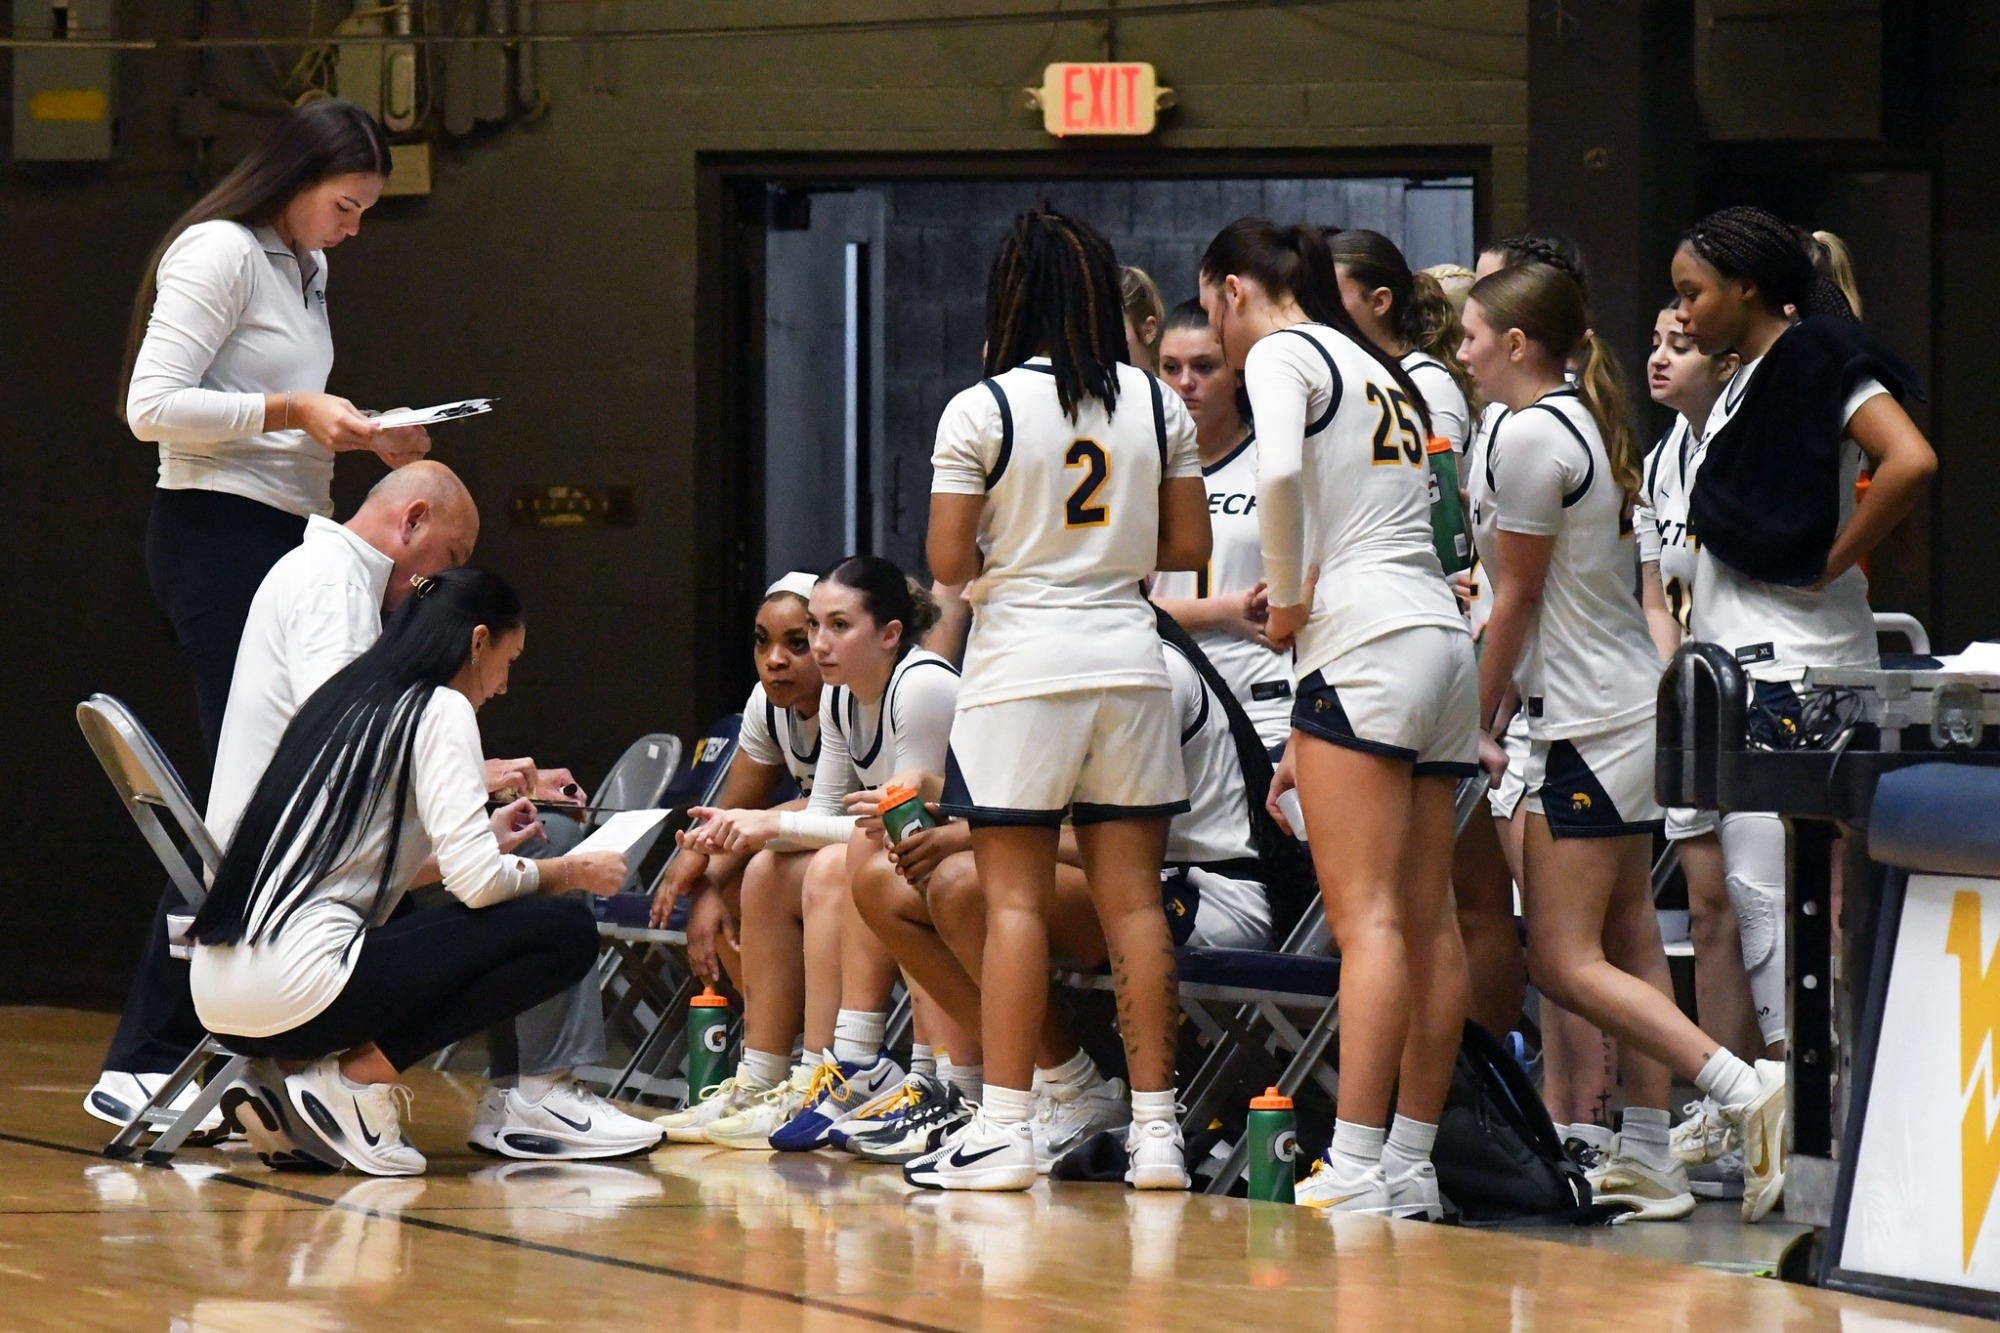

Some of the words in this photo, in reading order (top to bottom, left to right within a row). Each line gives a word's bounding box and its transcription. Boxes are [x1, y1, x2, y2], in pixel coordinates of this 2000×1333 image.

[1064, 66, 1142, 128] EXIT
[1366, 380, 1424, 469] 25
[1065, 437, 1111, 529] 2
[1759, 647, 1771, 656] XL
[704, 1023, 727, 1053] G
